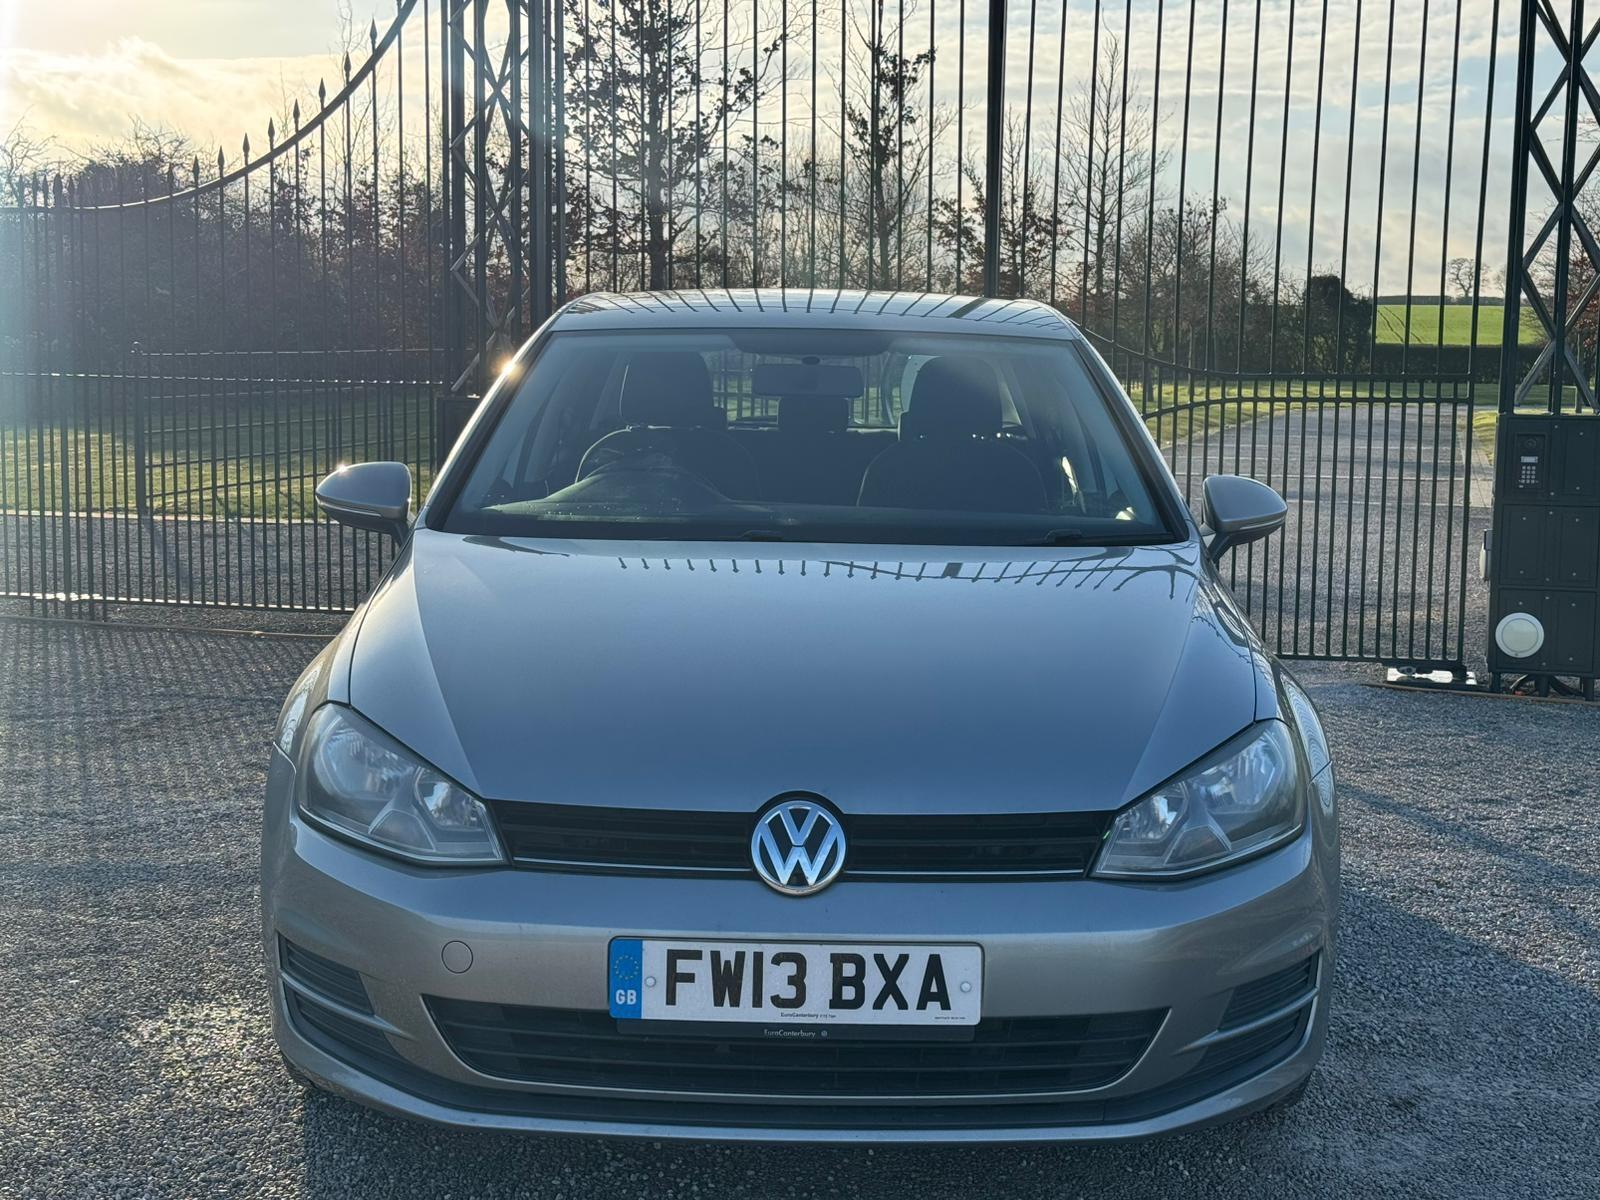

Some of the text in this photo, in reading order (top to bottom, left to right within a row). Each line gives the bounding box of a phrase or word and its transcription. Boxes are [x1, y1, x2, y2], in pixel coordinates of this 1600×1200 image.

[758, 804, 840, 888] VW
[615, 989, 637, 1005] GB
[665, 948, 952, 1011] FW13 BXA
[763, 1029, 816, 1038] EuroCanterbury
